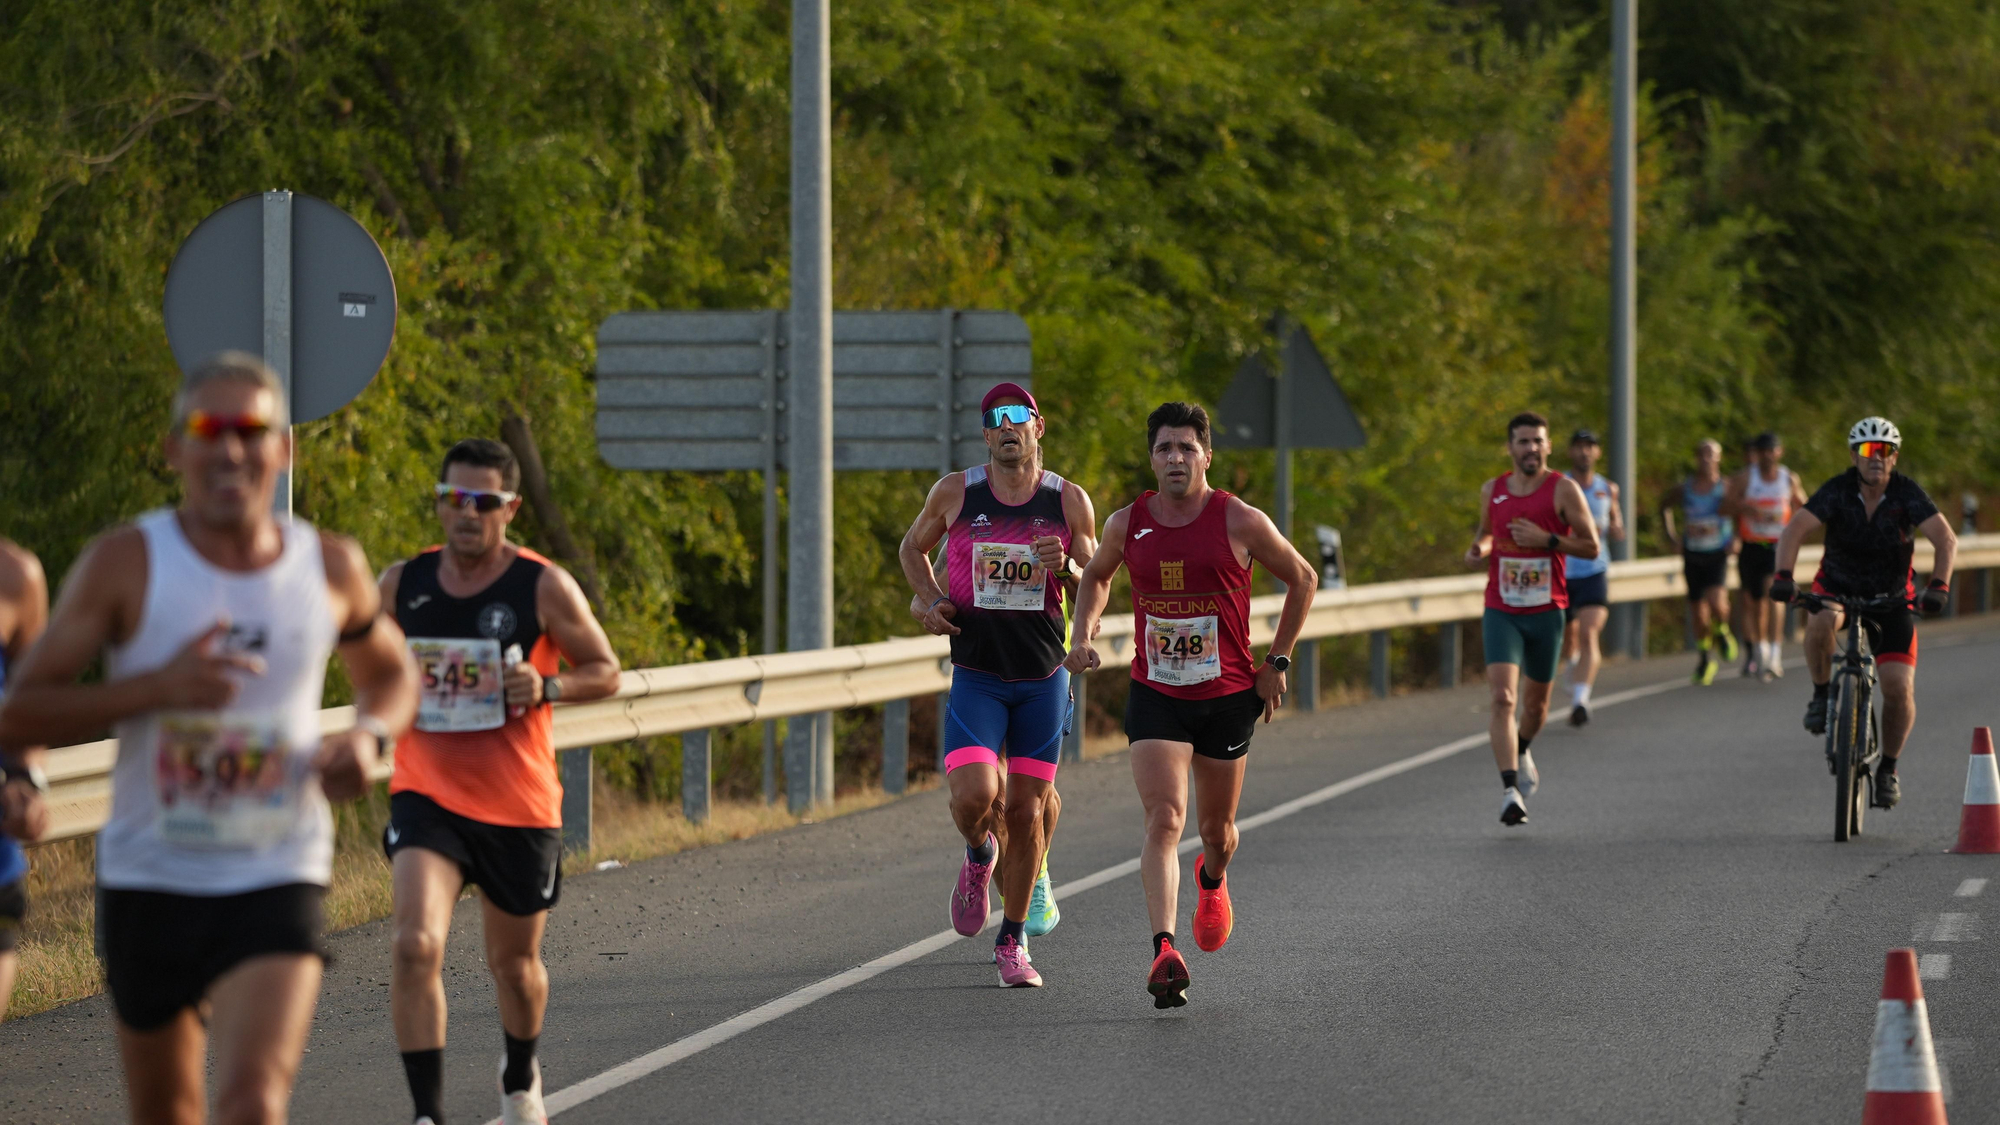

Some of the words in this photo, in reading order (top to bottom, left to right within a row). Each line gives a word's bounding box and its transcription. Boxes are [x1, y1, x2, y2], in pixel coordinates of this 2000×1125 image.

[988, 560, 1032, 581] 200
[1509, 570, 1539, 586] 263
[1139, 597, 1219, 614] PORCUNA
[1160, 635, 1203, 656] 248
[424, 663, 479, 689] 545
